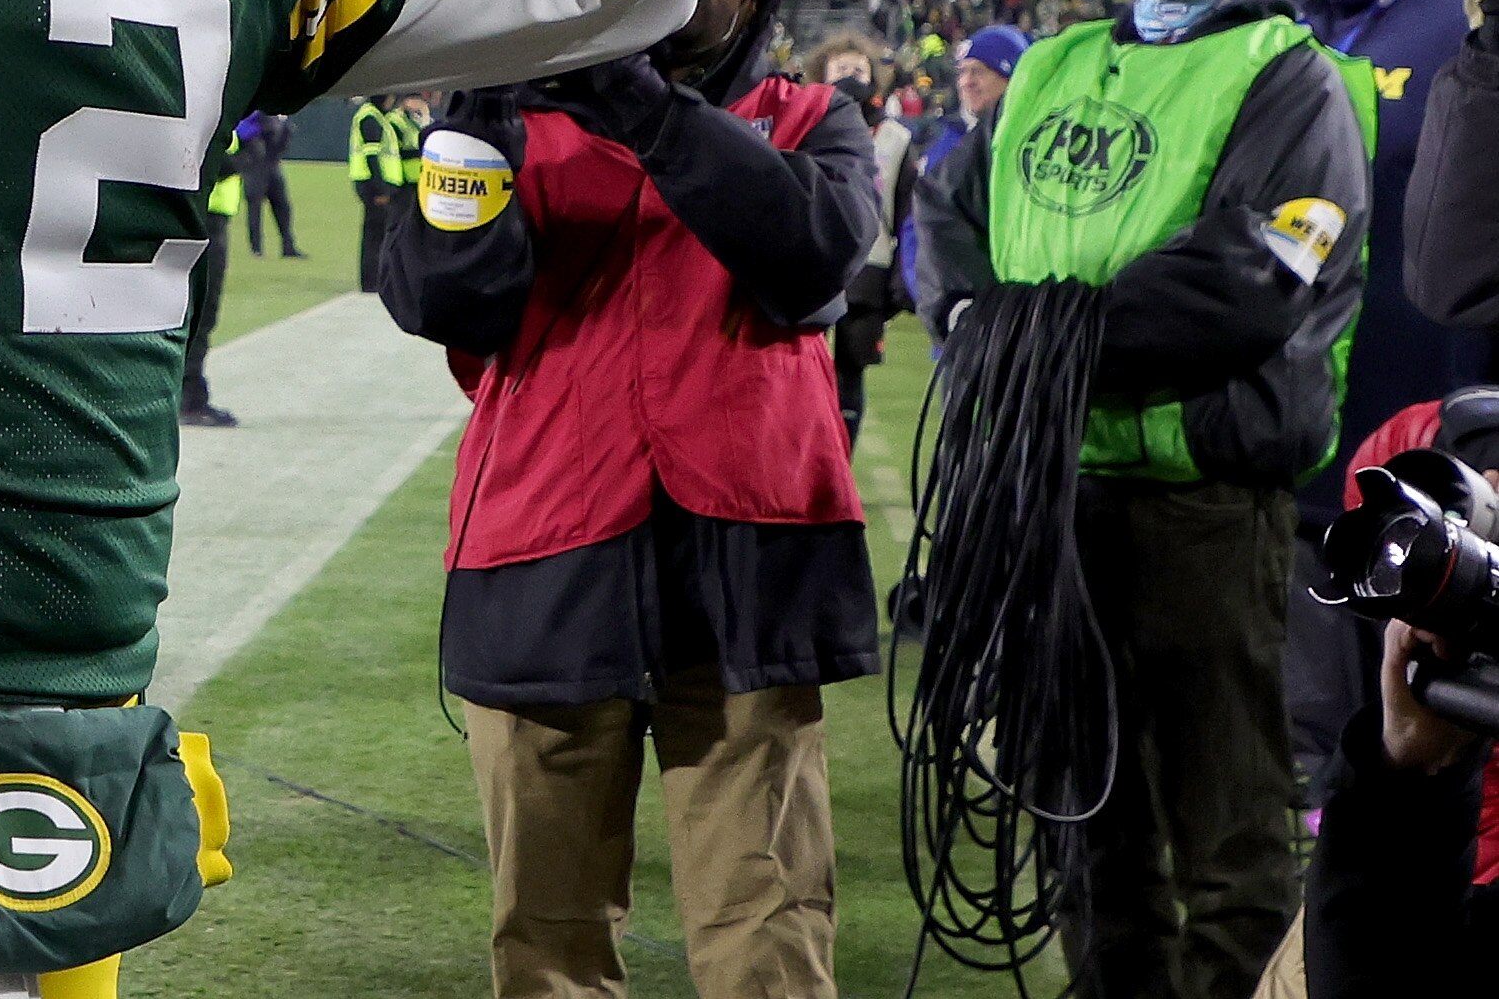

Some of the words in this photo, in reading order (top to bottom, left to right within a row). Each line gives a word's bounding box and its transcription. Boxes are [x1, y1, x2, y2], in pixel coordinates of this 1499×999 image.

[1044, 119, 1127, 171] FOX
[438, 177, 488, 196] WEEK
[1034, 161, 1108, 192] SPORTS
